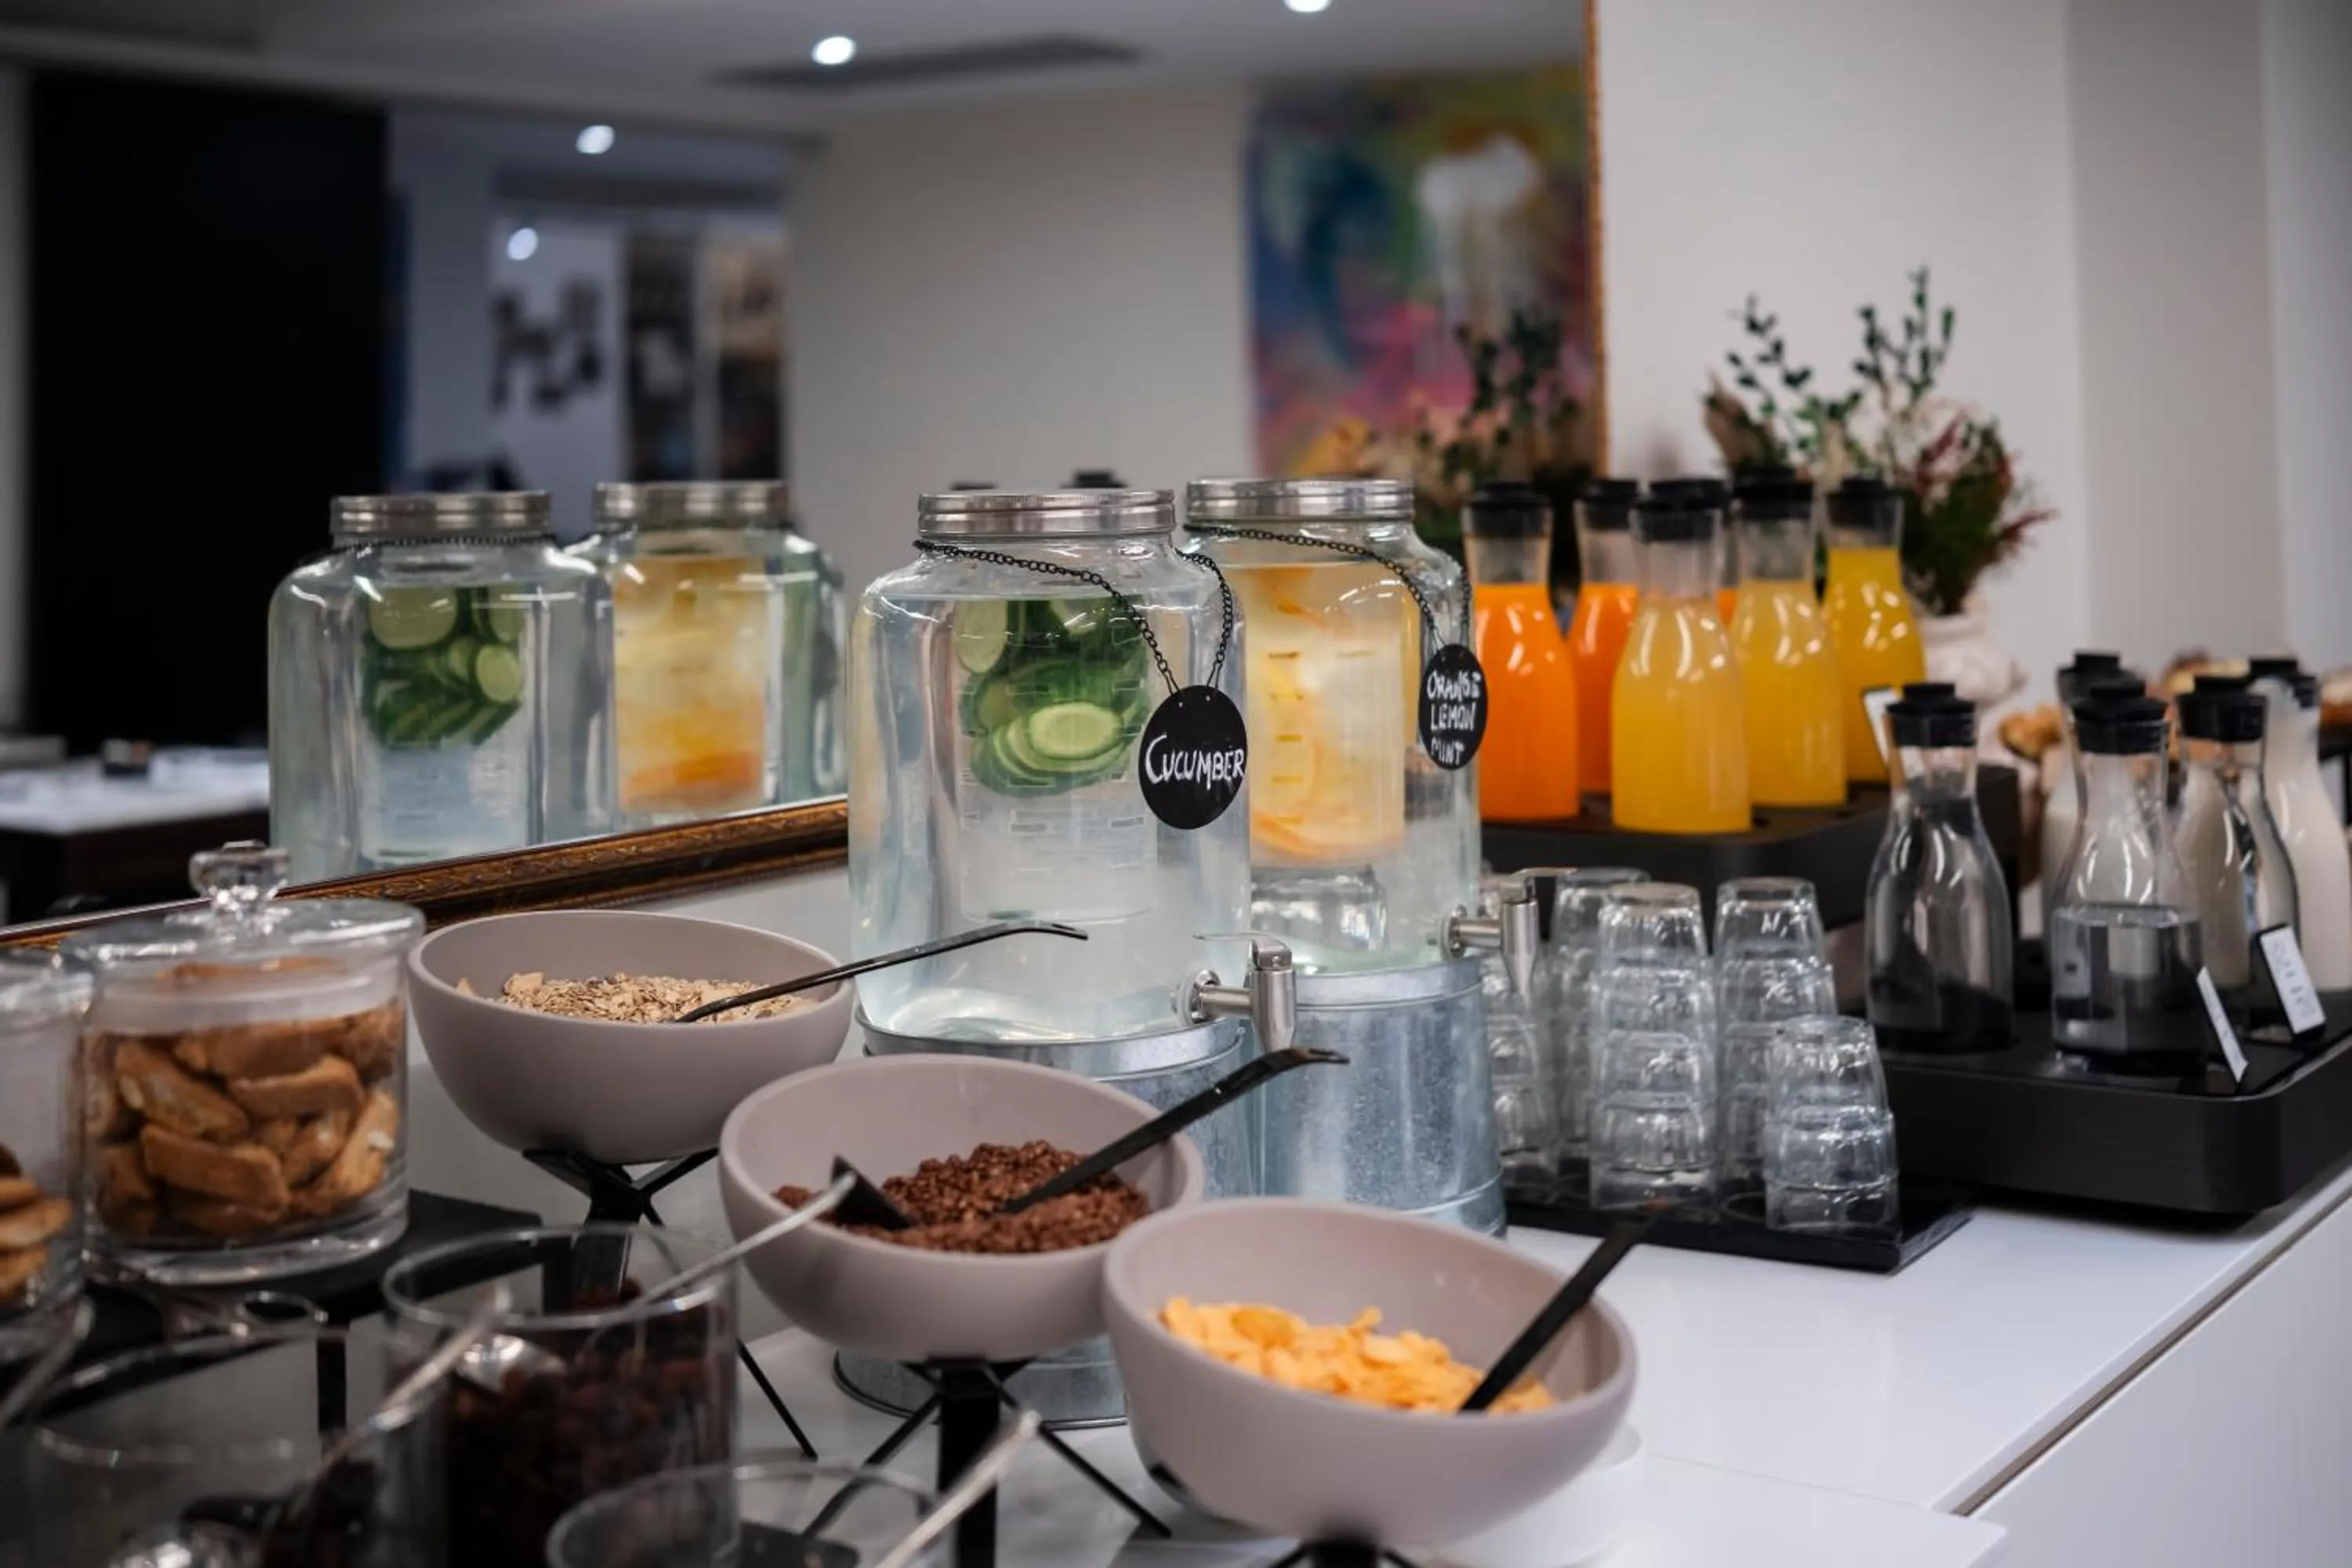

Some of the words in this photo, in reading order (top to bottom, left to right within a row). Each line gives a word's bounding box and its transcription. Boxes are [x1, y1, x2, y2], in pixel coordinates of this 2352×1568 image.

[1427, 670, 1482, 702] ORANGE
[1431, 702, 1476, 731] LEMON
[1145, 734, 1246, 790] CUCUMBER
[1431, 736, 1465, 765] MINT
